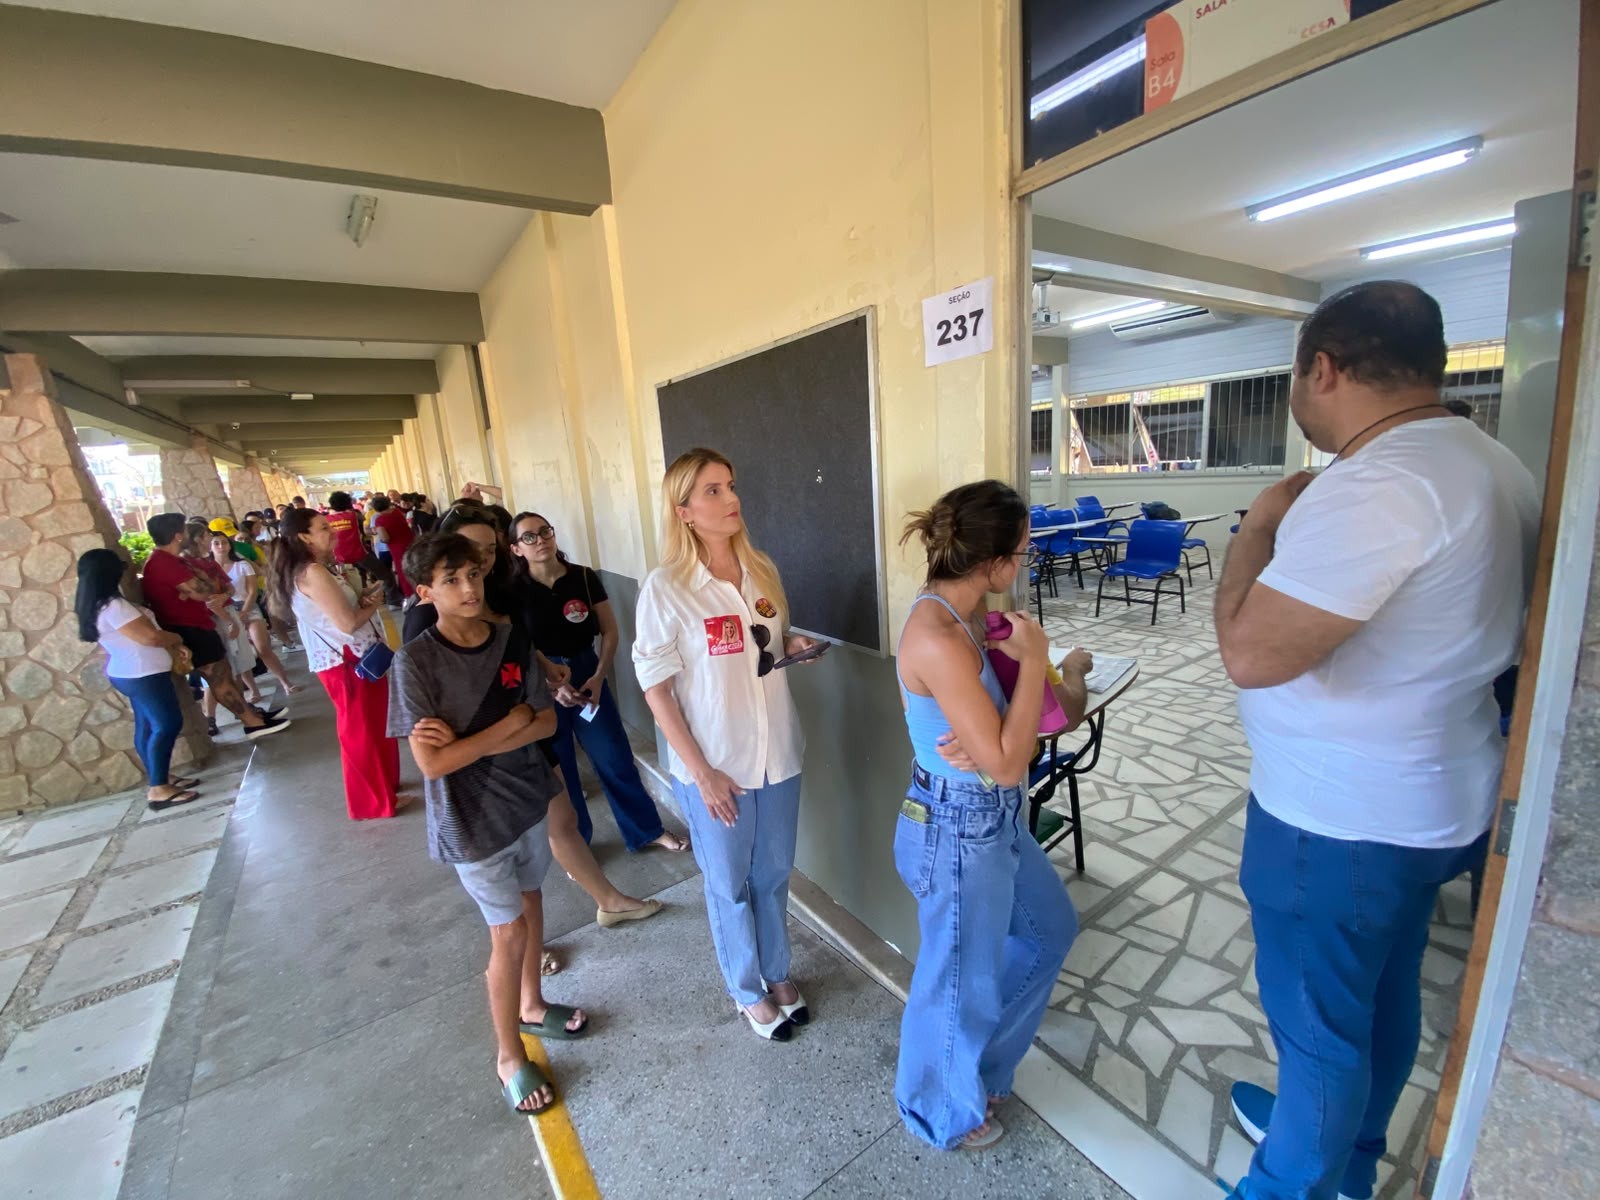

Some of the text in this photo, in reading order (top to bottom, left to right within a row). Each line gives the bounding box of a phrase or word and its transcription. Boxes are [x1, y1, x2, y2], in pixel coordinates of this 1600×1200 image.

[1150, 51, 1176, 71] Sala
[1148, 66, 1176, 98] B4
[948, 291, 971, 304] SEÇÃO
[936, 308, 984, 346] 237
